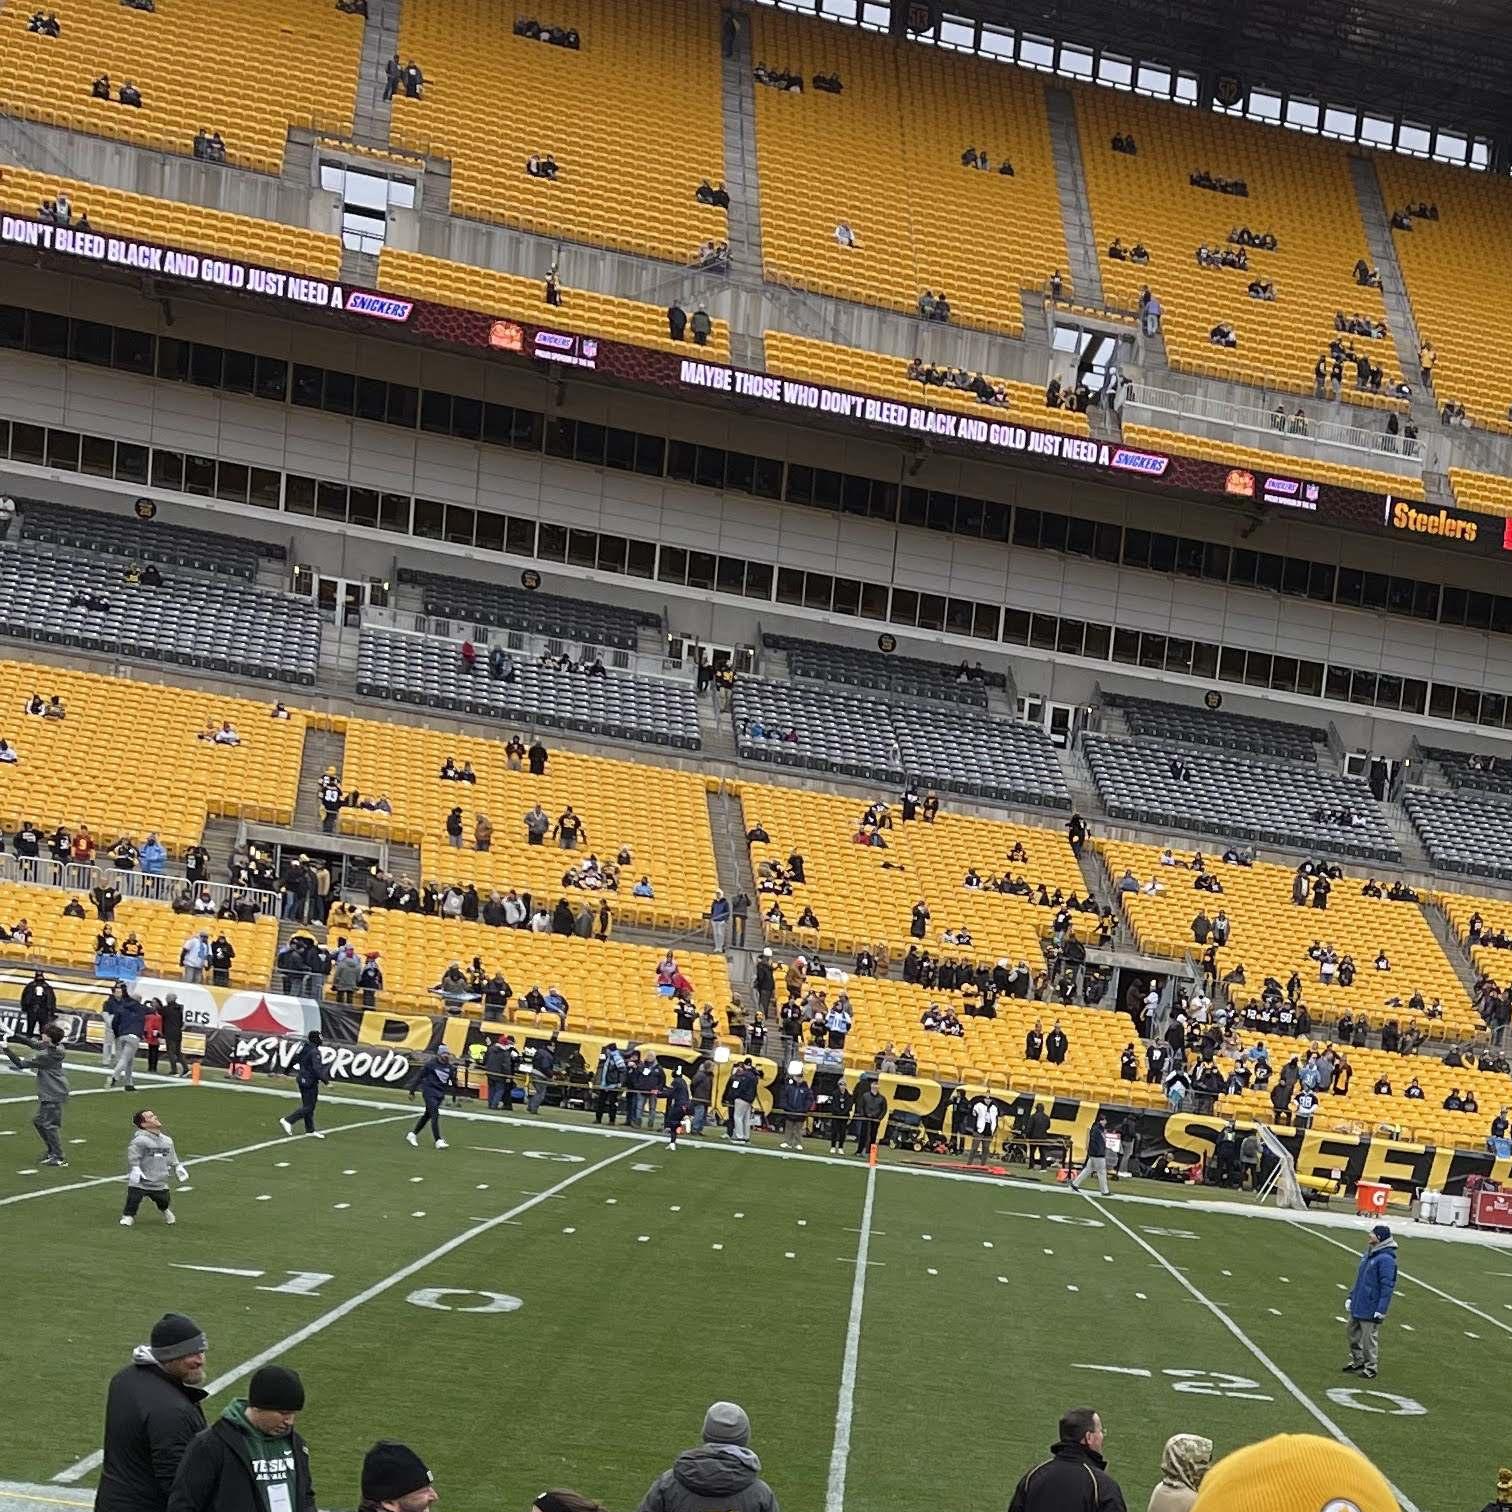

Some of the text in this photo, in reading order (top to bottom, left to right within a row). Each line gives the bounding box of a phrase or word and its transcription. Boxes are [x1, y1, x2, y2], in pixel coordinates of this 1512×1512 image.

[2, 217, 409, 318] DON'T BLEED BLACK AND GOLD JUST NEED A SNICKERS
[680, 360, 1164, 472] MAYBE THOSE WHO DON'T BLEED BLACK AND GOLD JUST NEED A SNICKERS
[1393, 502, 1478, 541] Steelers
